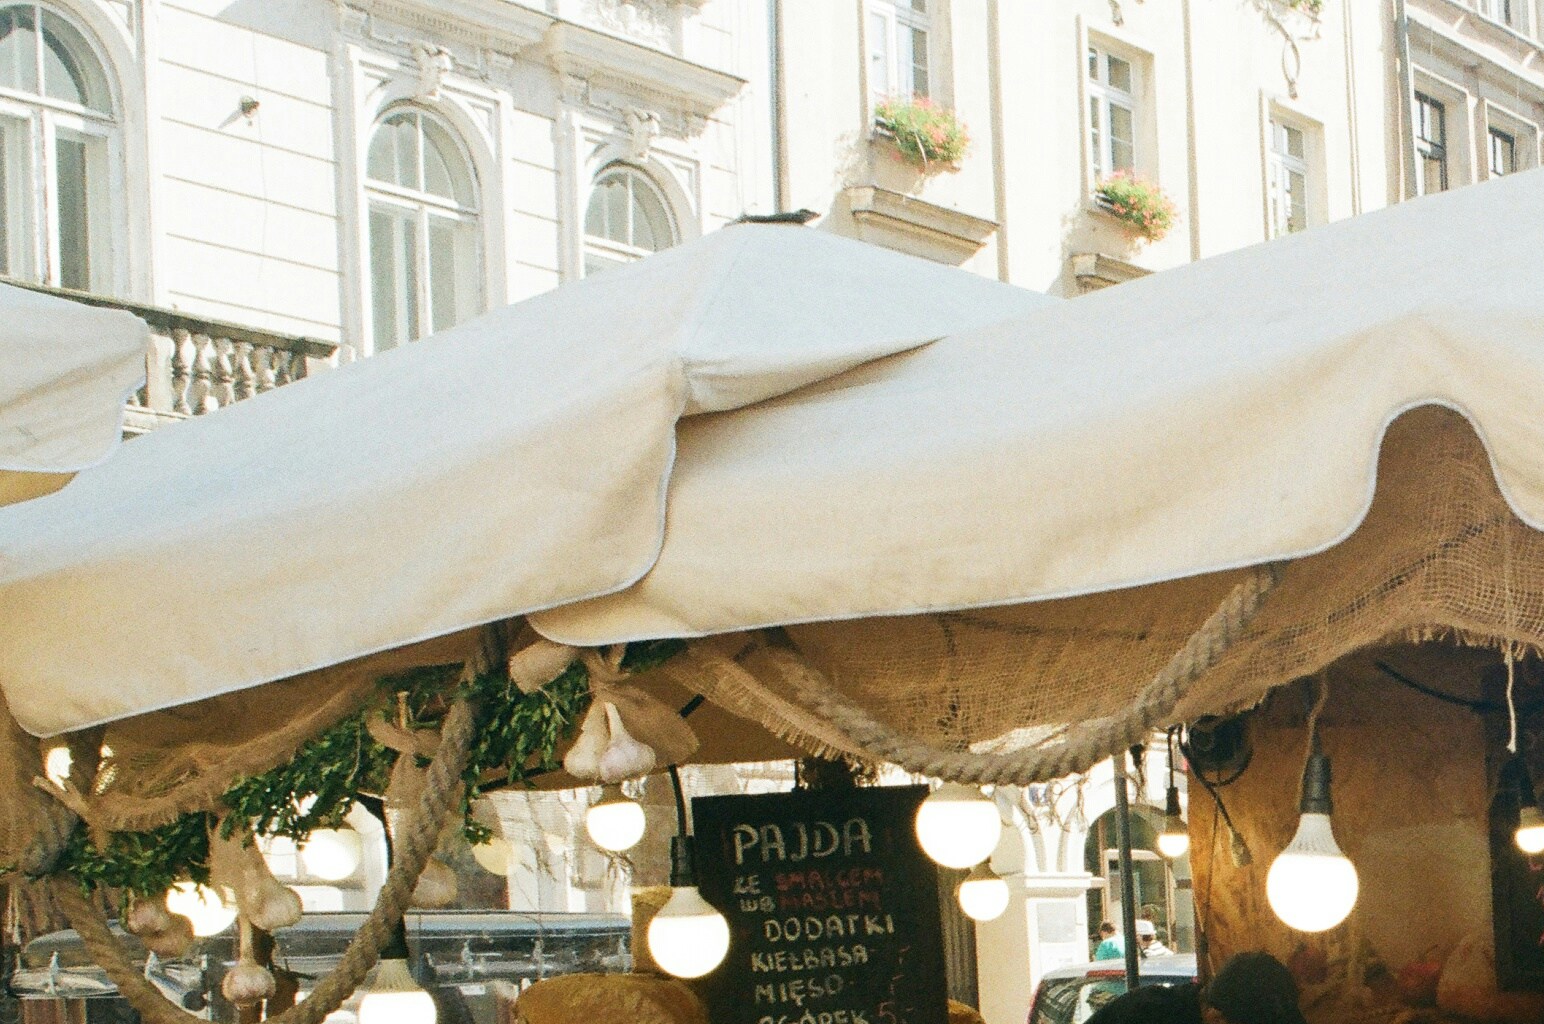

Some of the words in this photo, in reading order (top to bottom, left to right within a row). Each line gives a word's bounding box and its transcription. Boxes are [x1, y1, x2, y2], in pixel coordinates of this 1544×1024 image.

[733, 817, 871, 865] PAJDA
[764, 914, 895, 942] DODATKI
[751, 945, 868, 973] KIEŁBASA
[756, 973, 843, 1006] MIĘSO
